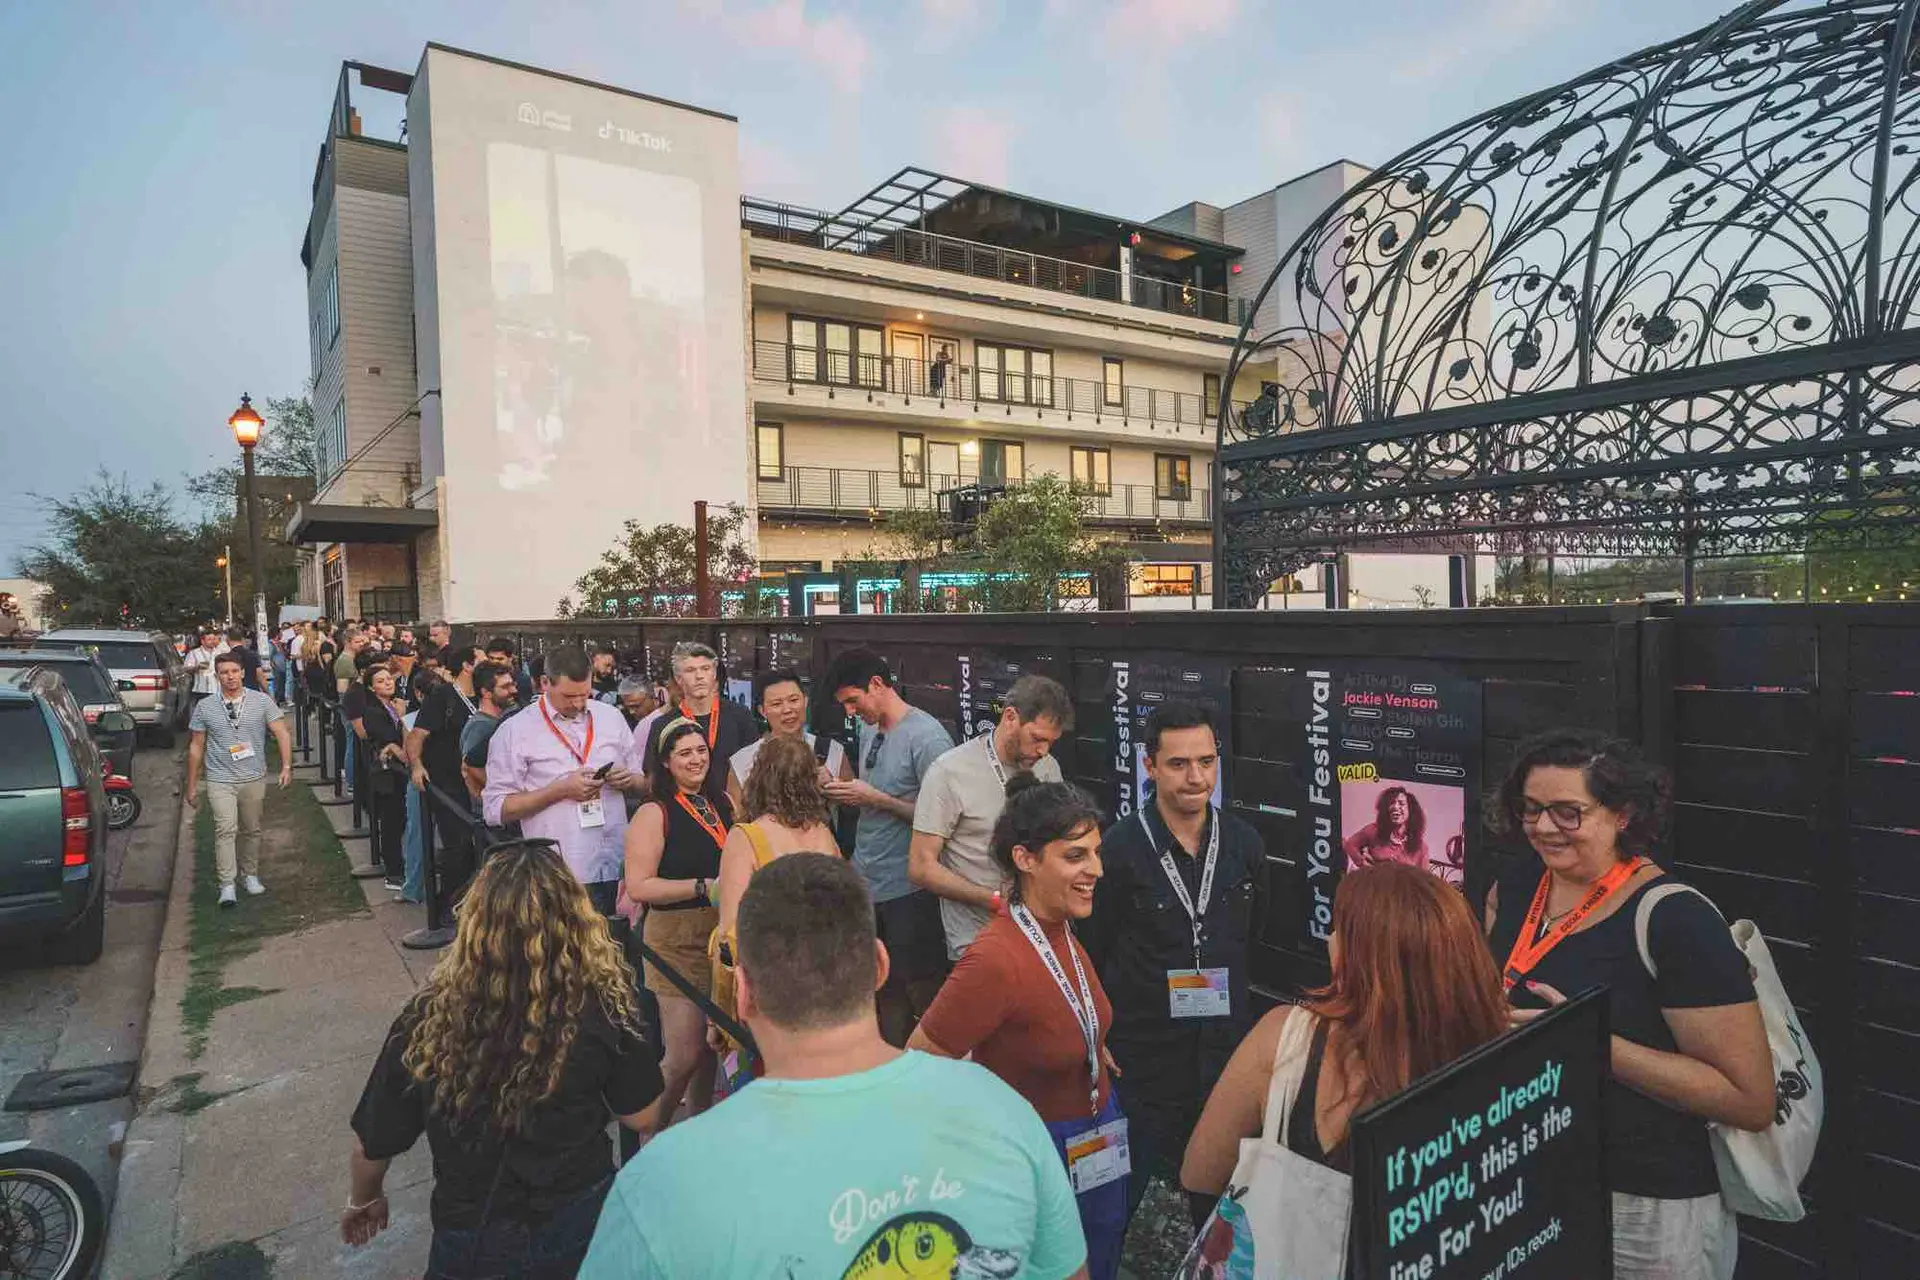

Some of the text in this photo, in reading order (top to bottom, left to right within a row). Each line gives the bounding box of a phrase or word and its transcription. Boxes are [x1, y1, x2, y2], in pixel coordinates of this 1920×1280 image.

[617, 128, 674, 153] TikTok
[1112, 661, 1131, 773] Festival
[1342, 690, 1438, 709] Jackie Venson
[1306, 670, 1332, 941] For You Festival
[1387, 1060, 1562, 1191] If you've already
[1389, 1105, 1572, 1248] RSVP'd, this is the
[830, 1167, 966, 1244] Don't be
[1390, 1177, 1524, 1280] line For You!
[1506, 1246, 1526, 1272] IDs
[1527, 1217, 1563, 1255] ready.
